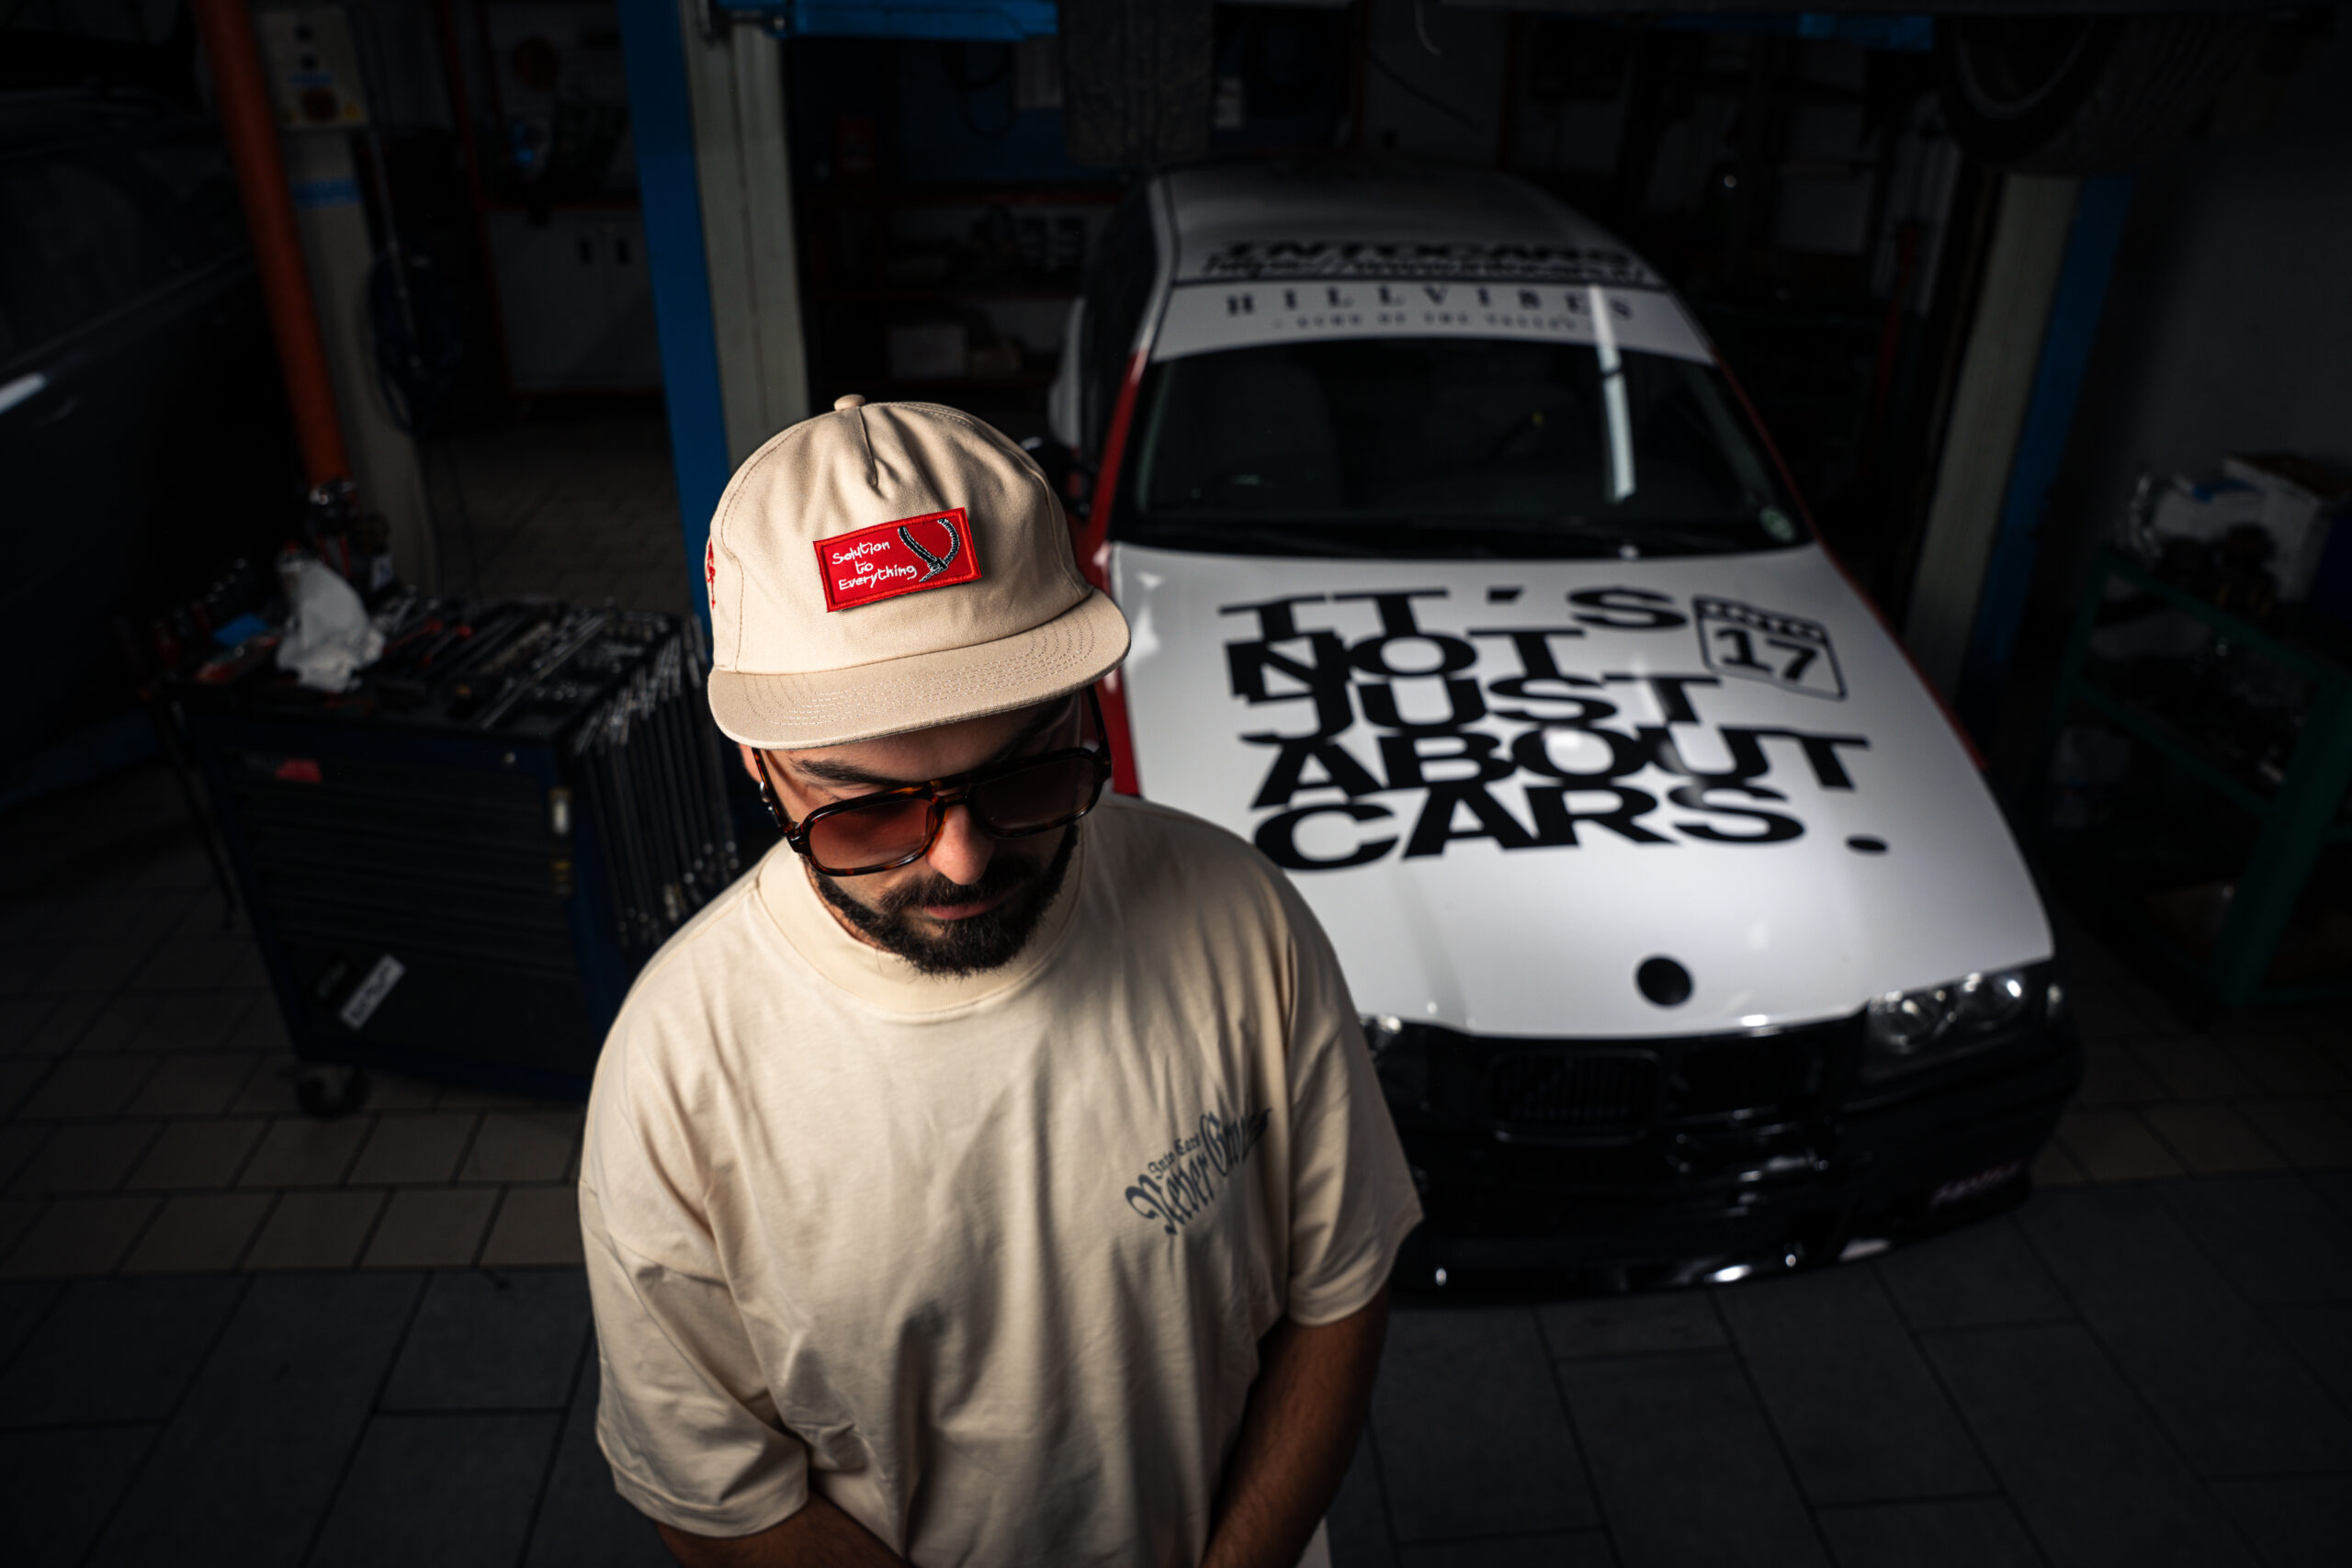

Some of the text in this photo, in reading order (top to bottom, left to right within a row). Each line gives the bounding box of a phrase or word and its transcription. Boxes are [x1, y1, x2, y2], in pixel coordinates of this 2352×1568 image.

[1227, 285, 1633, 320] HILLVIBES
[831, 541, 891, 565] Solution
[838, 564, 918, 591] Everything
[854, 560, 875, 575] to
[1218, 586, 1688, 641] IT'S
[1224, 626, 1586, 698] NOT
[1716, 628, 1817, 682] 17
[1239, 671, 1723, 745] JUST
[1250, 725, 1871, 810] ABOUT
